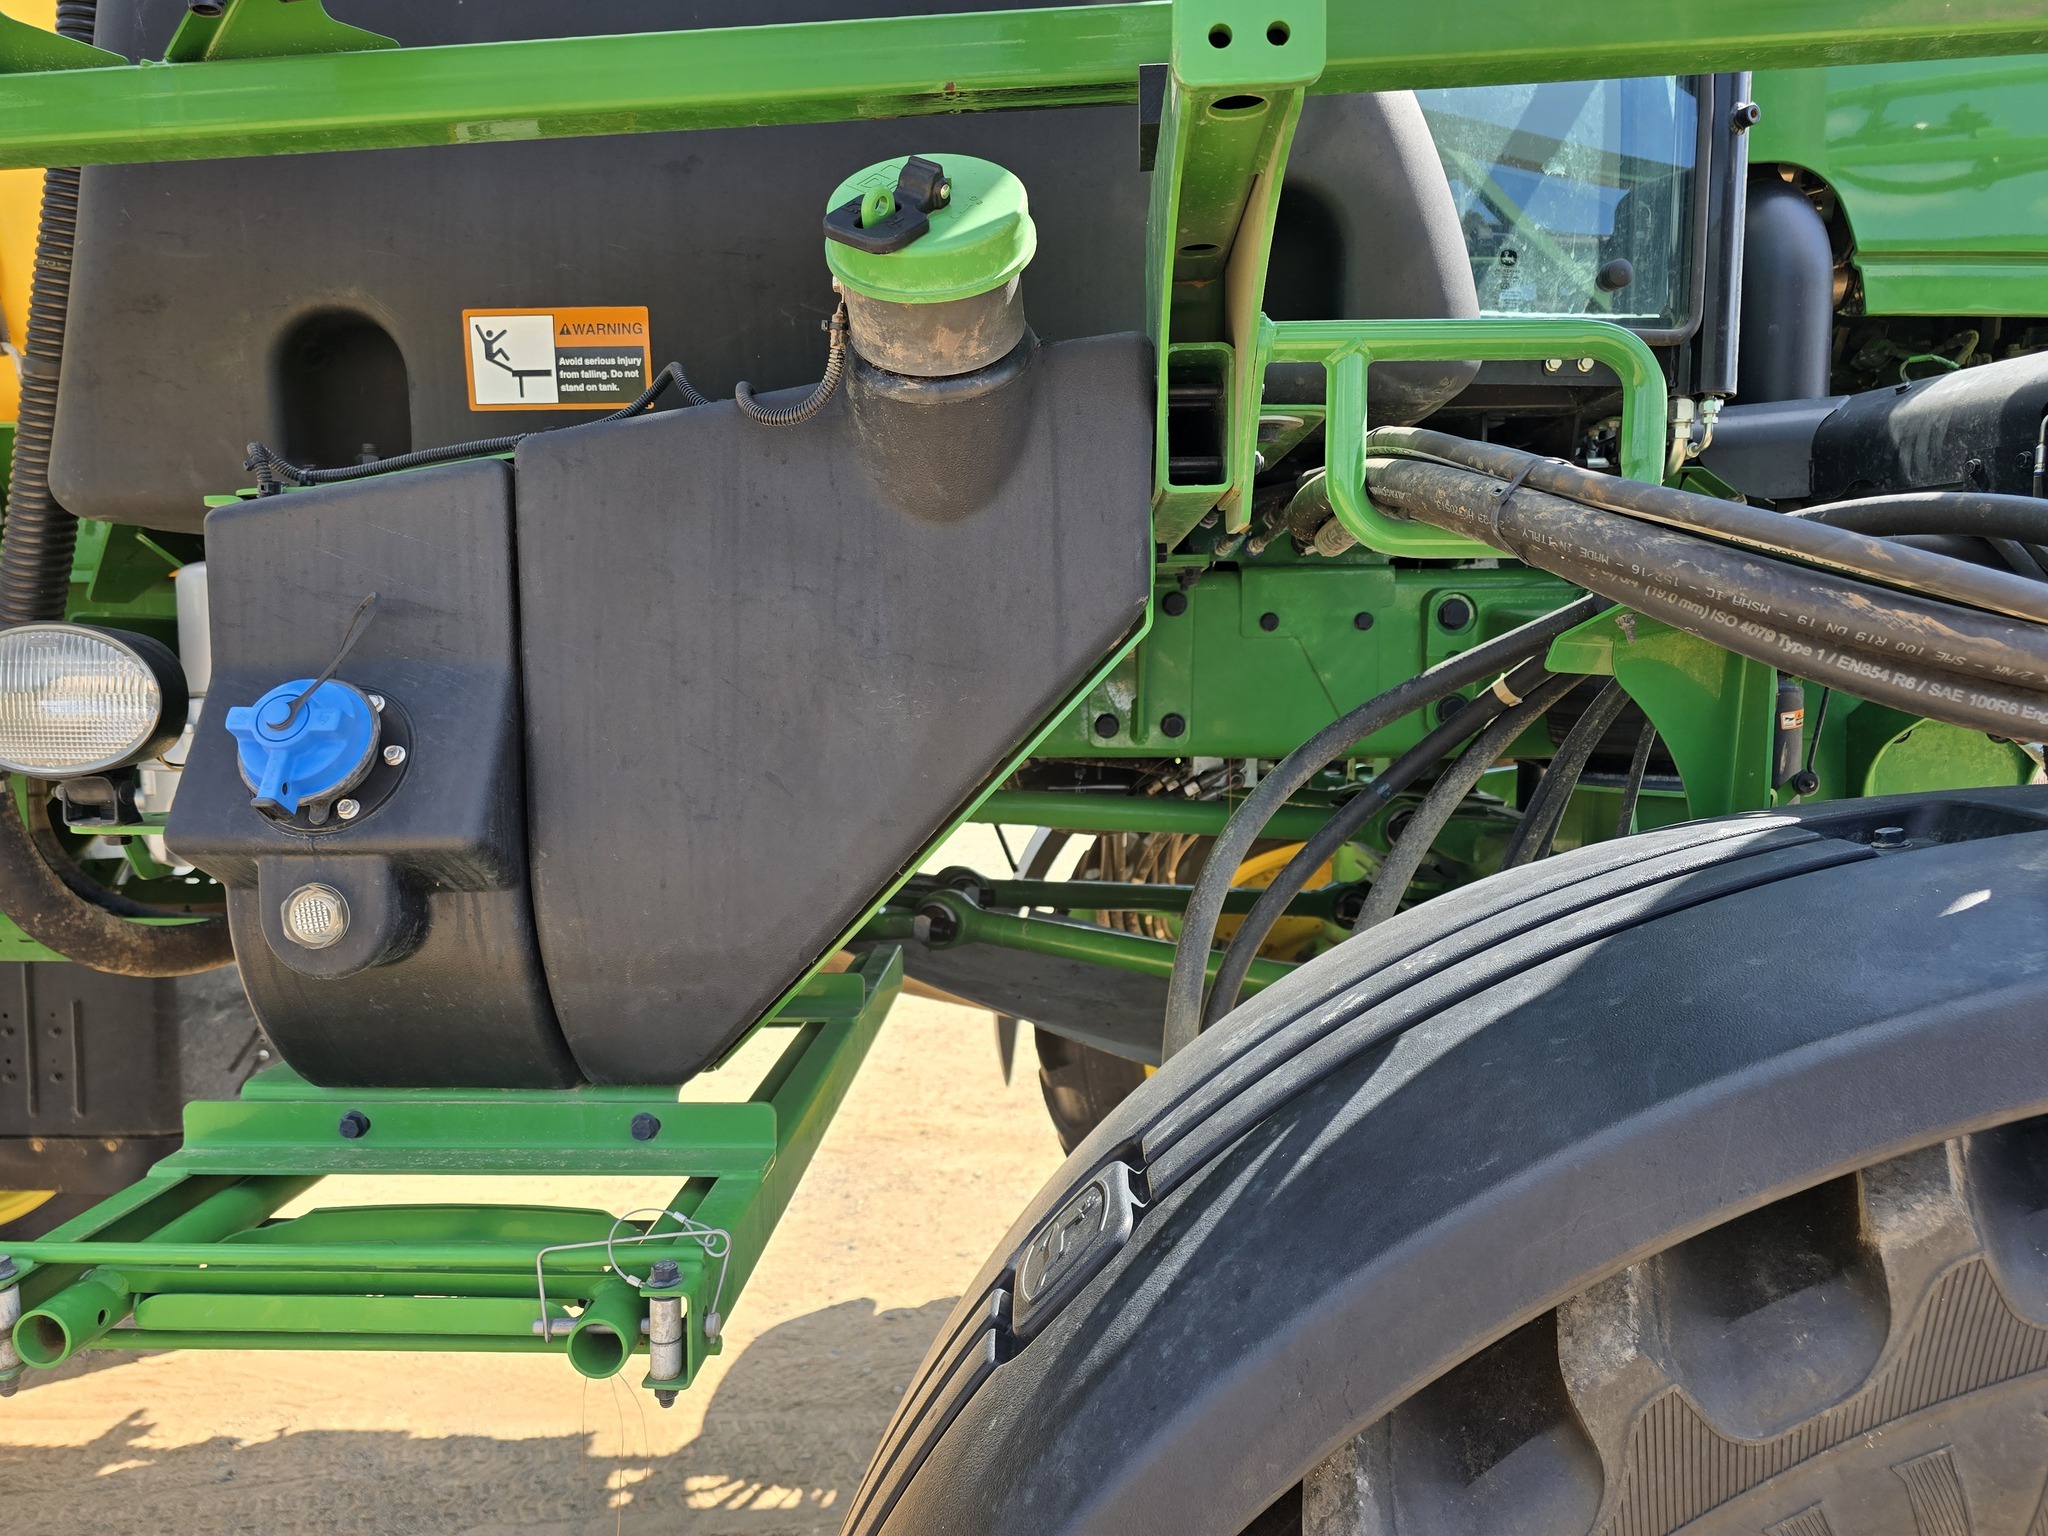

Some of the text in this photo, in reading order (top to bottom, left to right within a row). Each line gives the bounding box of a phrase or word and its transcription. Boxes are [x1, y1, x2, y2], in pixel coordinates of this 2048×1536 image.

[572, 322, 643, 335] WARNING
[559, 356, 642, 367] Avoid serious injury
[559, 369, 639, 380] from falling. Do not
[560, 383, 585, 392] stand
[598, 382, 620, 392] tank.
[1521, 527, 1553, 546] ITALY
[1560, 540, 1573, 552] IN
[1580, 546, 1609, 565] MADE
[1705, 586, 1724, 600] IC
[1732, 595, 1772, 615] MSHA
[1797, 615, 1816, 628] 19
[1825, 622, 1848, 636] DN
[1855, 631, 1888, 647] R19
[1895, 642, 1925, 656] 100
[1678, 598, 1710, 620] mm)
[1710, 608, 1739, 628] ISO
[1739, 620, 1777, 643] 4079
[1778, 632, 1813, 657] Type
[1817, 648, 1825, 661] 1
[1836, 654, 1890, 682] EN854
[1892, 672, 1917, 690] R6
[1928, 683, 1965, 703] SAE
[1969, 693, 2020, 716] 100R6
[1936, 651, 1967, 666] SAE
